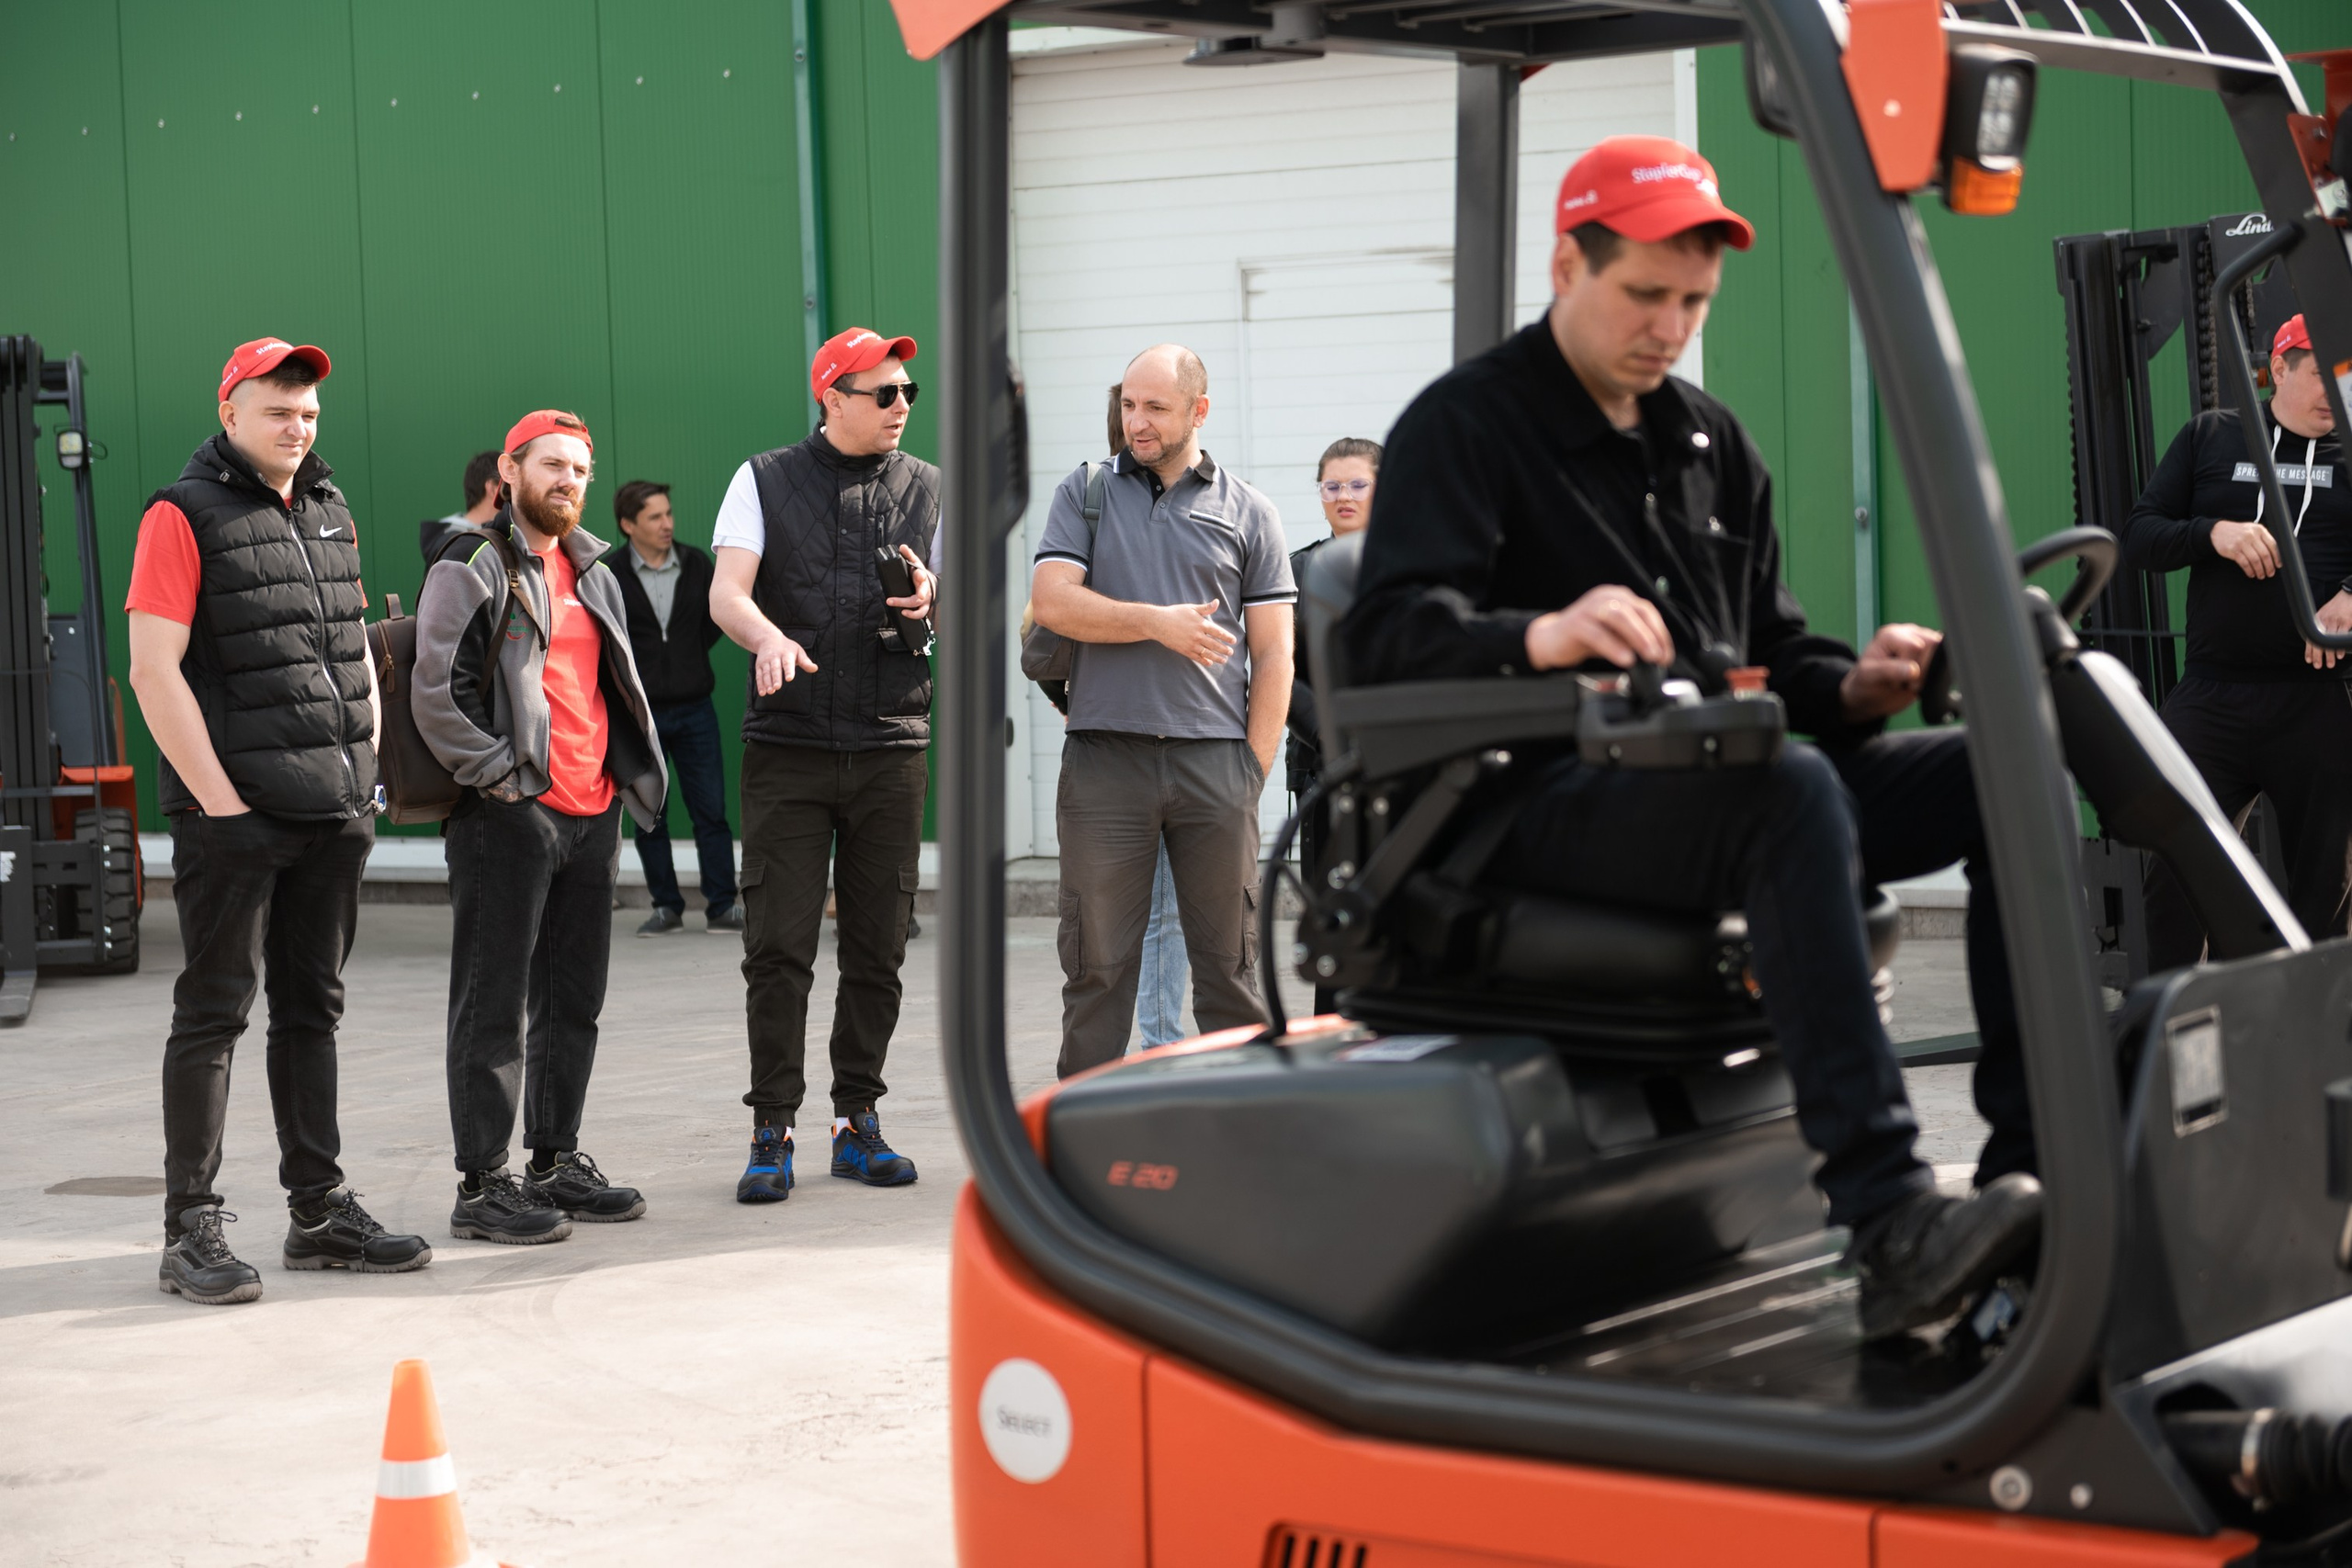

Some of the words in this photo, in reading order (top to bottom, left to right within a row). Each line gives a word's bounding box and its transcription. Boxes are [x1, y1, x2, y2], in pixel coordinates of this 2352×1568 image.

[2224, 212, 2275, 237] Lind
[2289, 468, 2326, 481] MESAGE
[1107, 1160, 1133, 1186] E
[1132, 1162, 1179, 1190] 20
